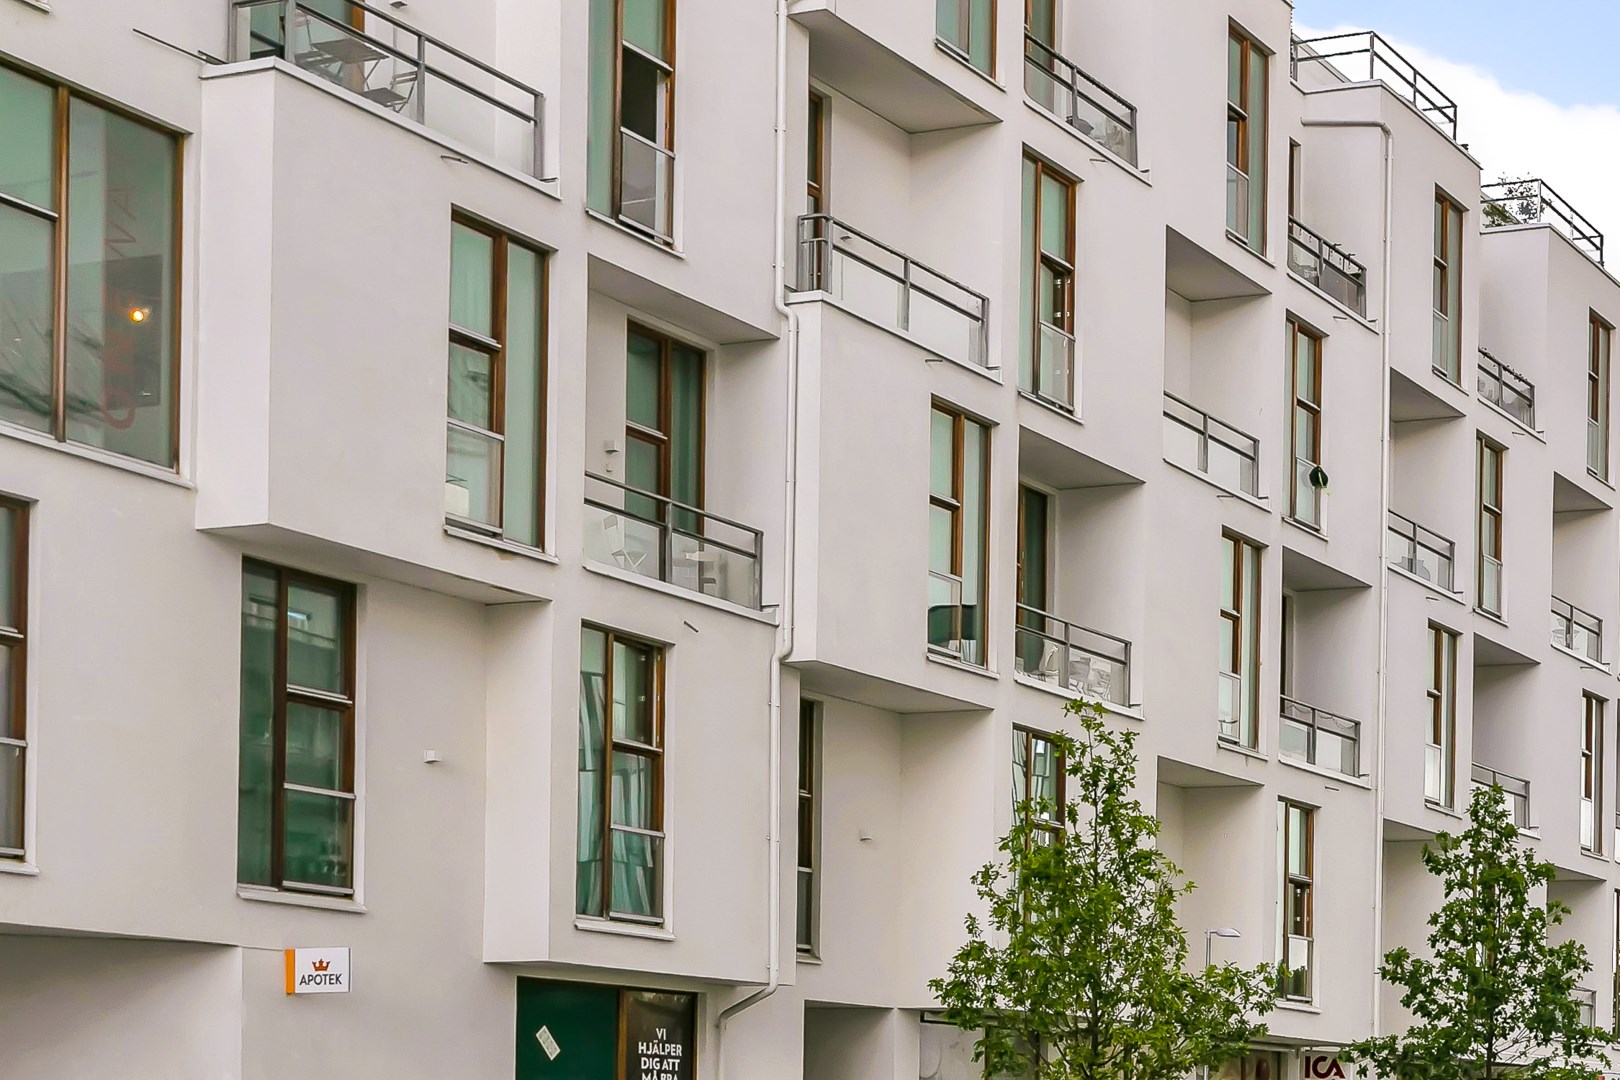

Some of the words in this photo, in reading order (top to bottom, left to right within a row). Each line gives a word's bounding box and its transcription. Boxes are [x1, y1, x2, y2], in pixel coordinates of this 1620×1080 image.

[299, 973, 343, 986] APOTEK
[655, 1027, 667, 1040] VI
[638, 1040, 683, 1057] HJÄLPER
[641, 1057, 661, 1070] DIG
[661, 1059, 681, 1072] ATT
[1304, 1055, 1346, 1079] ICA
